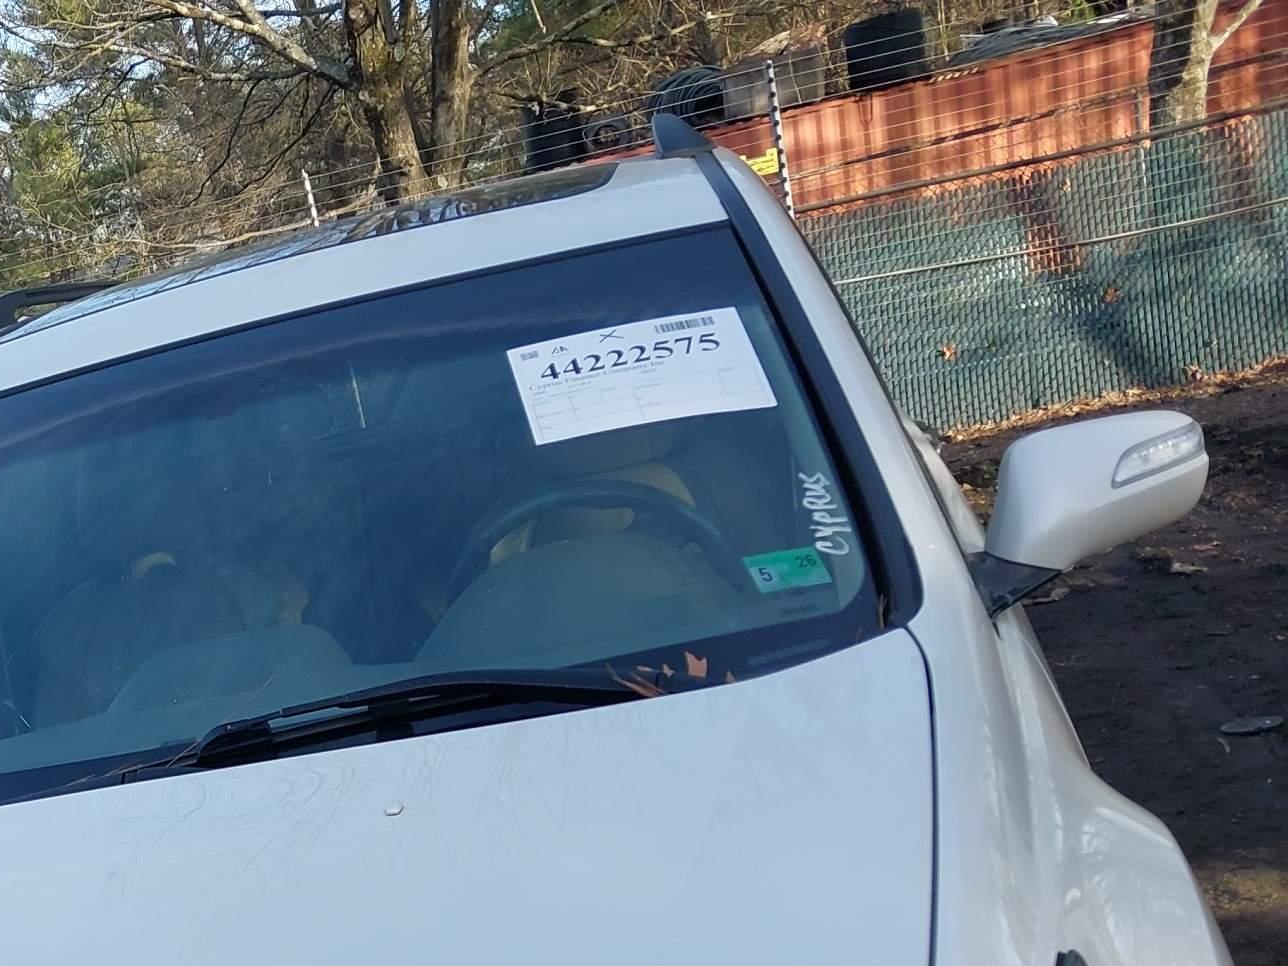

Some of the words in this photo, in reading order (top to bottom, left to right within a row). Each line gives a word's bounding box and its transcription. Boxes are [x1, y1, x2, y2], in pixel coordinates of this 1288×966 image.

[540, 332, 721, 381] 44222575
[798, 472, 852, 555] CYPRUS
[758, 567, 773, 582] 5
[795, 554, 817, 568] 26
